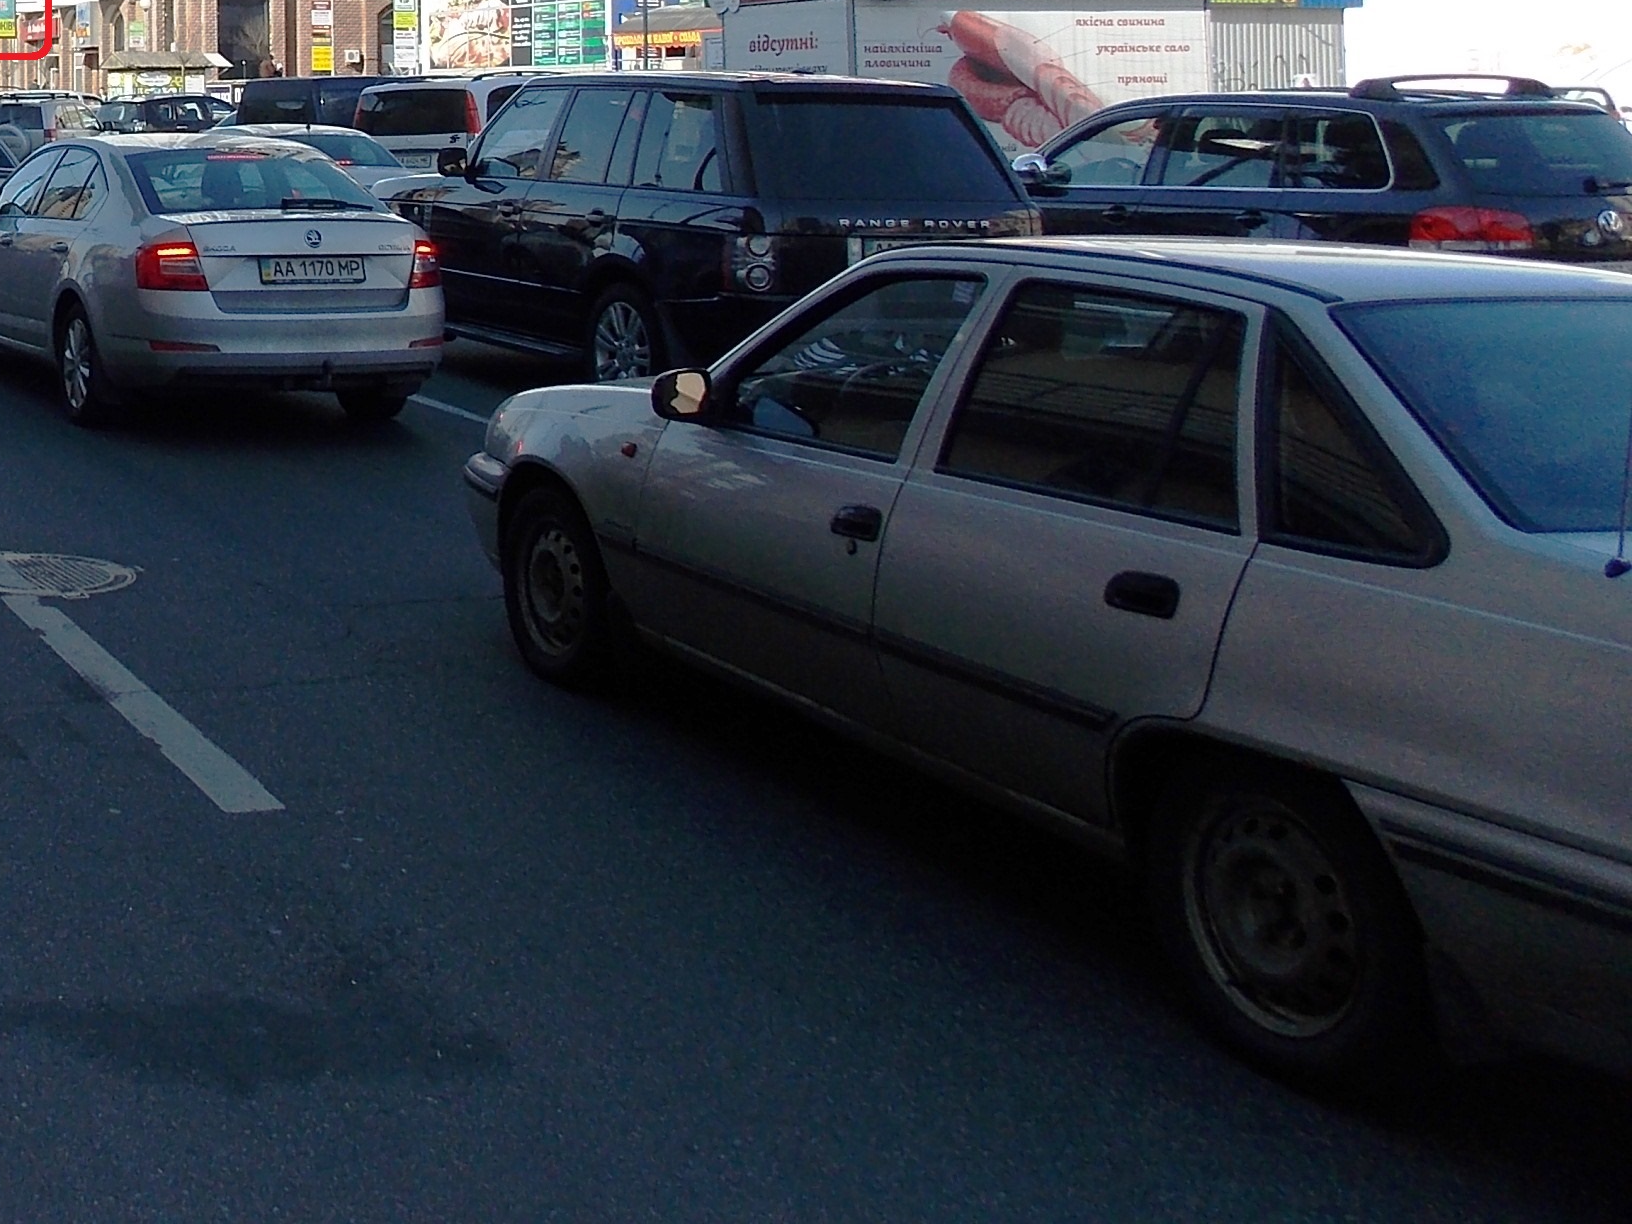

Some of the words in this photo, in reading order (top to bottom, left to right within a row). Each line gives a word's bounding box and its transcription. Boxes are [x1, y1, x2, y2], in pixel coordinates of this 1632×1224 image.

[1075, 16, 1114, 26] якісна
[1117, 17, 1165, 26] свинина
[749, 31, 818, 56] відсутні:
[864, 43, 943, 53] найякісніша
[1096, 44, 1162, 56] українське
[1164, 44, 1190, 52] сало
[1118, 73, 1168, 86] прянощі
[839, 219, 910, 227] RANGE
[924, 220, 990, 229] ROVER
[273, 261, 295, 276] AA
[299, 260, 334, 276] 1170
[339, 260, 360, 276] MP
